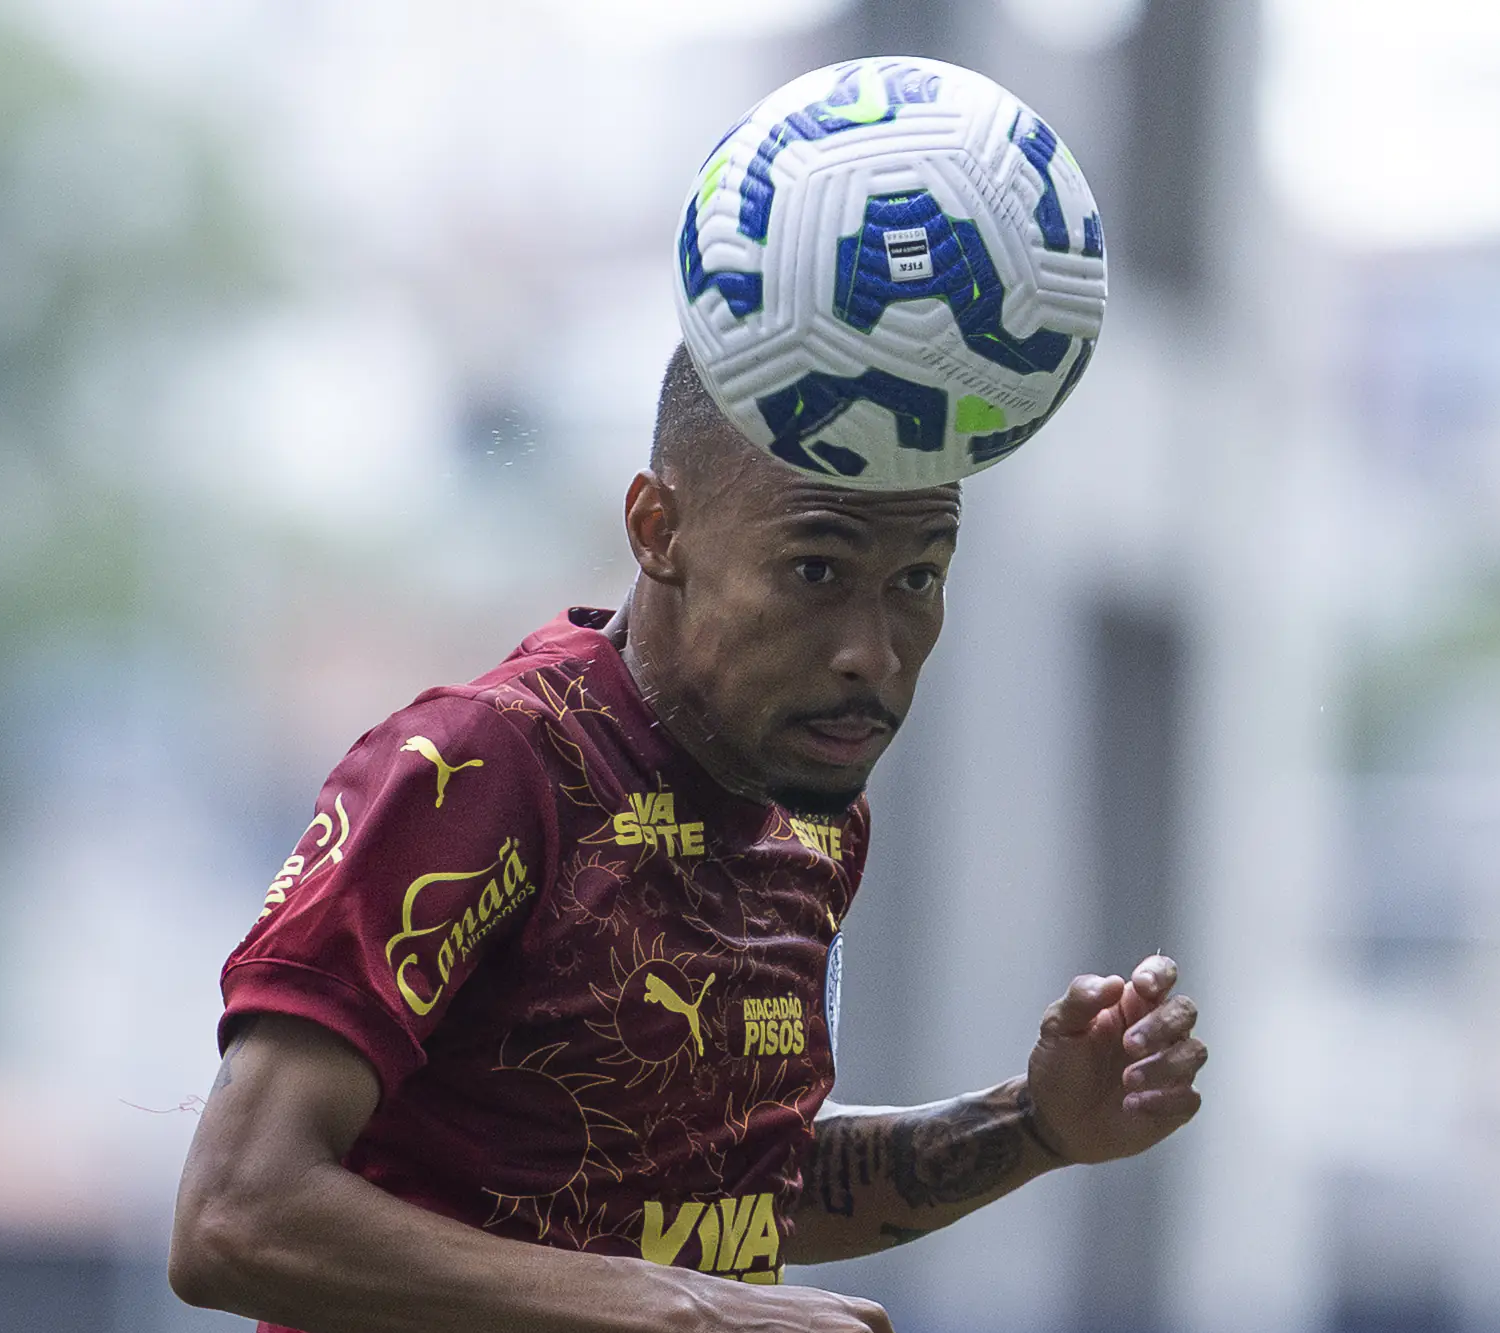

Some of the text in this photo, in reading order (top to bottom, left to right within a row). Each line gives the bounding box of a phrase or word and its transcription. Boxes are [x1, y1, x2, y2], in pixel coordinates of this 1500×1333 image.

[899, 261, 923, 272] FIFA
[628, 792, 675, 825] VA
[613, 811, 704, 857] STE
[397, 837, 528, 1016] Canaã
[460, 882, 537, 962] Alimentos
[743, 1019, 805, 1056] PISOS
[641, 1193, 780, 1272] VIVA
